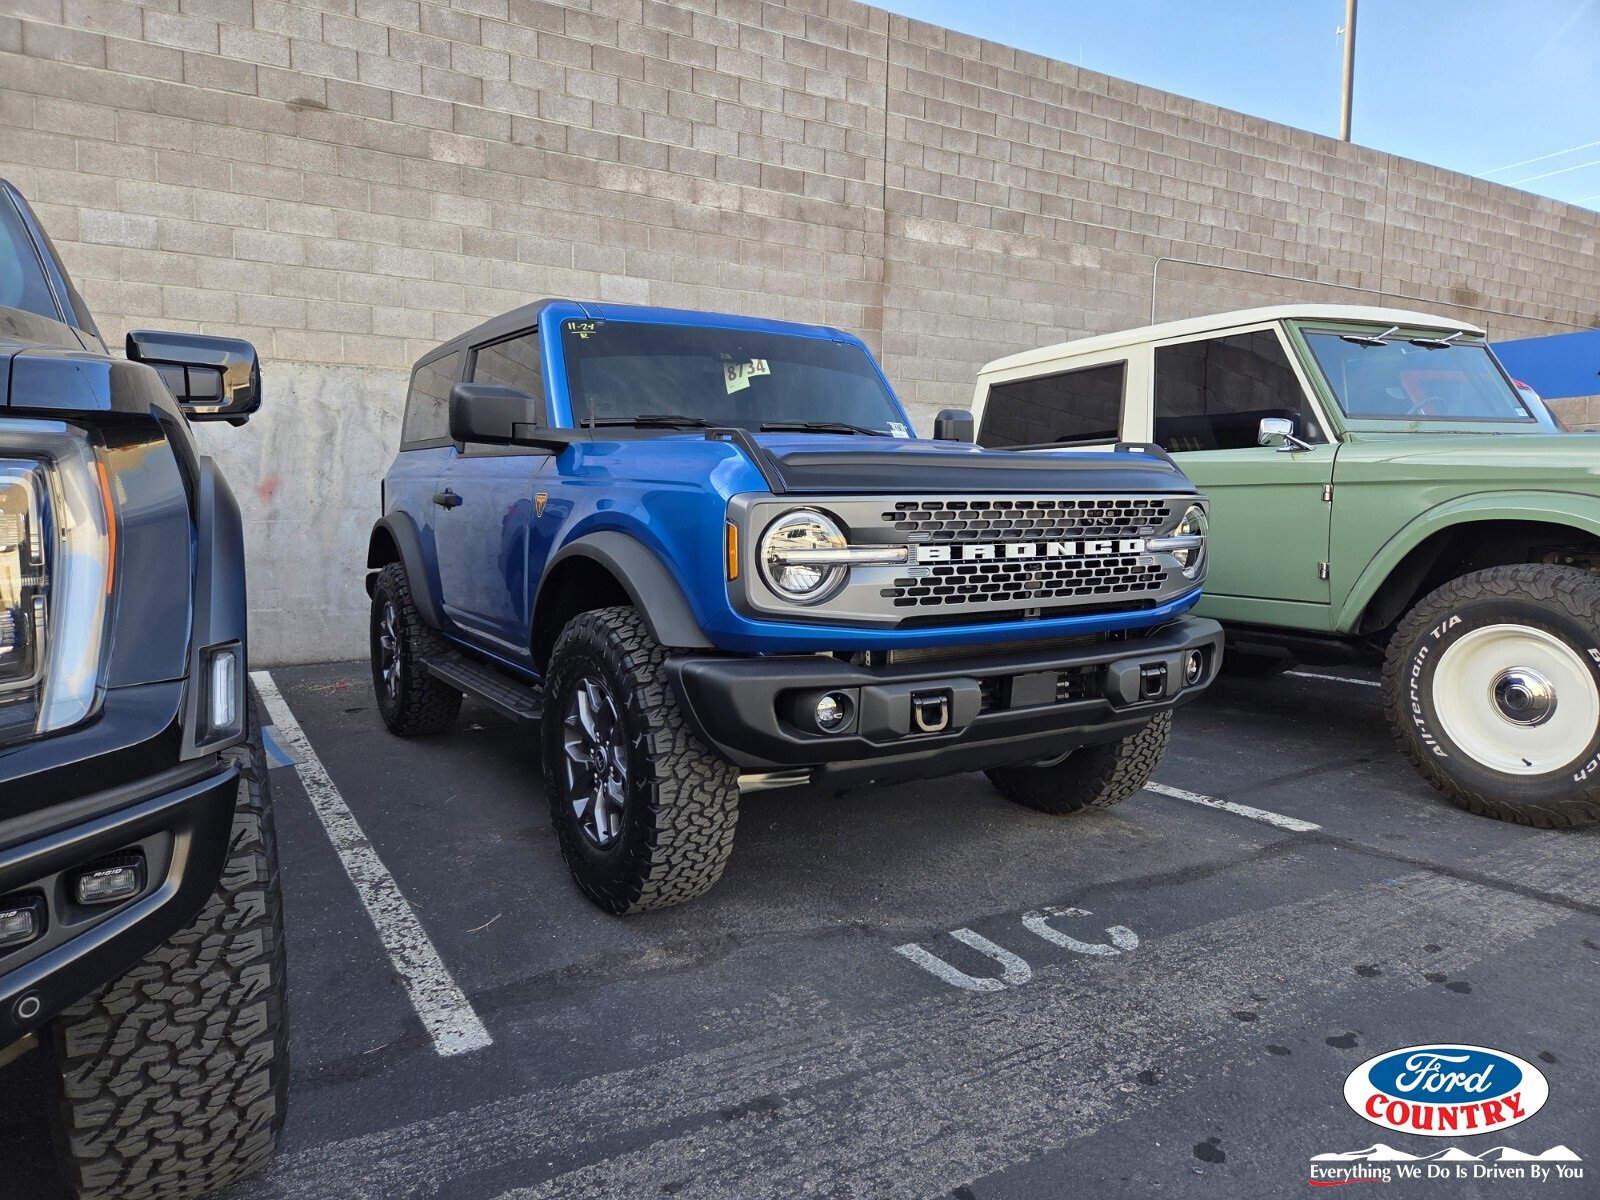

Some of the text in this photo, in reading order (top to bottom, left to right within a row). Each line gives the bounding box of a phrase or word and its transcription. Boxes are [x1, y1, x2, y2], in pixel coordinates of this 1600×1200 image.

[916, 538, 1146, 562] BRONCO
[1430, 614, 1462, 640] T/A
[1408, 646, 1449, 758] All-Terrain
[93, 868, 123, 878] RIGID
[893, 905, 1140, 992] UC
